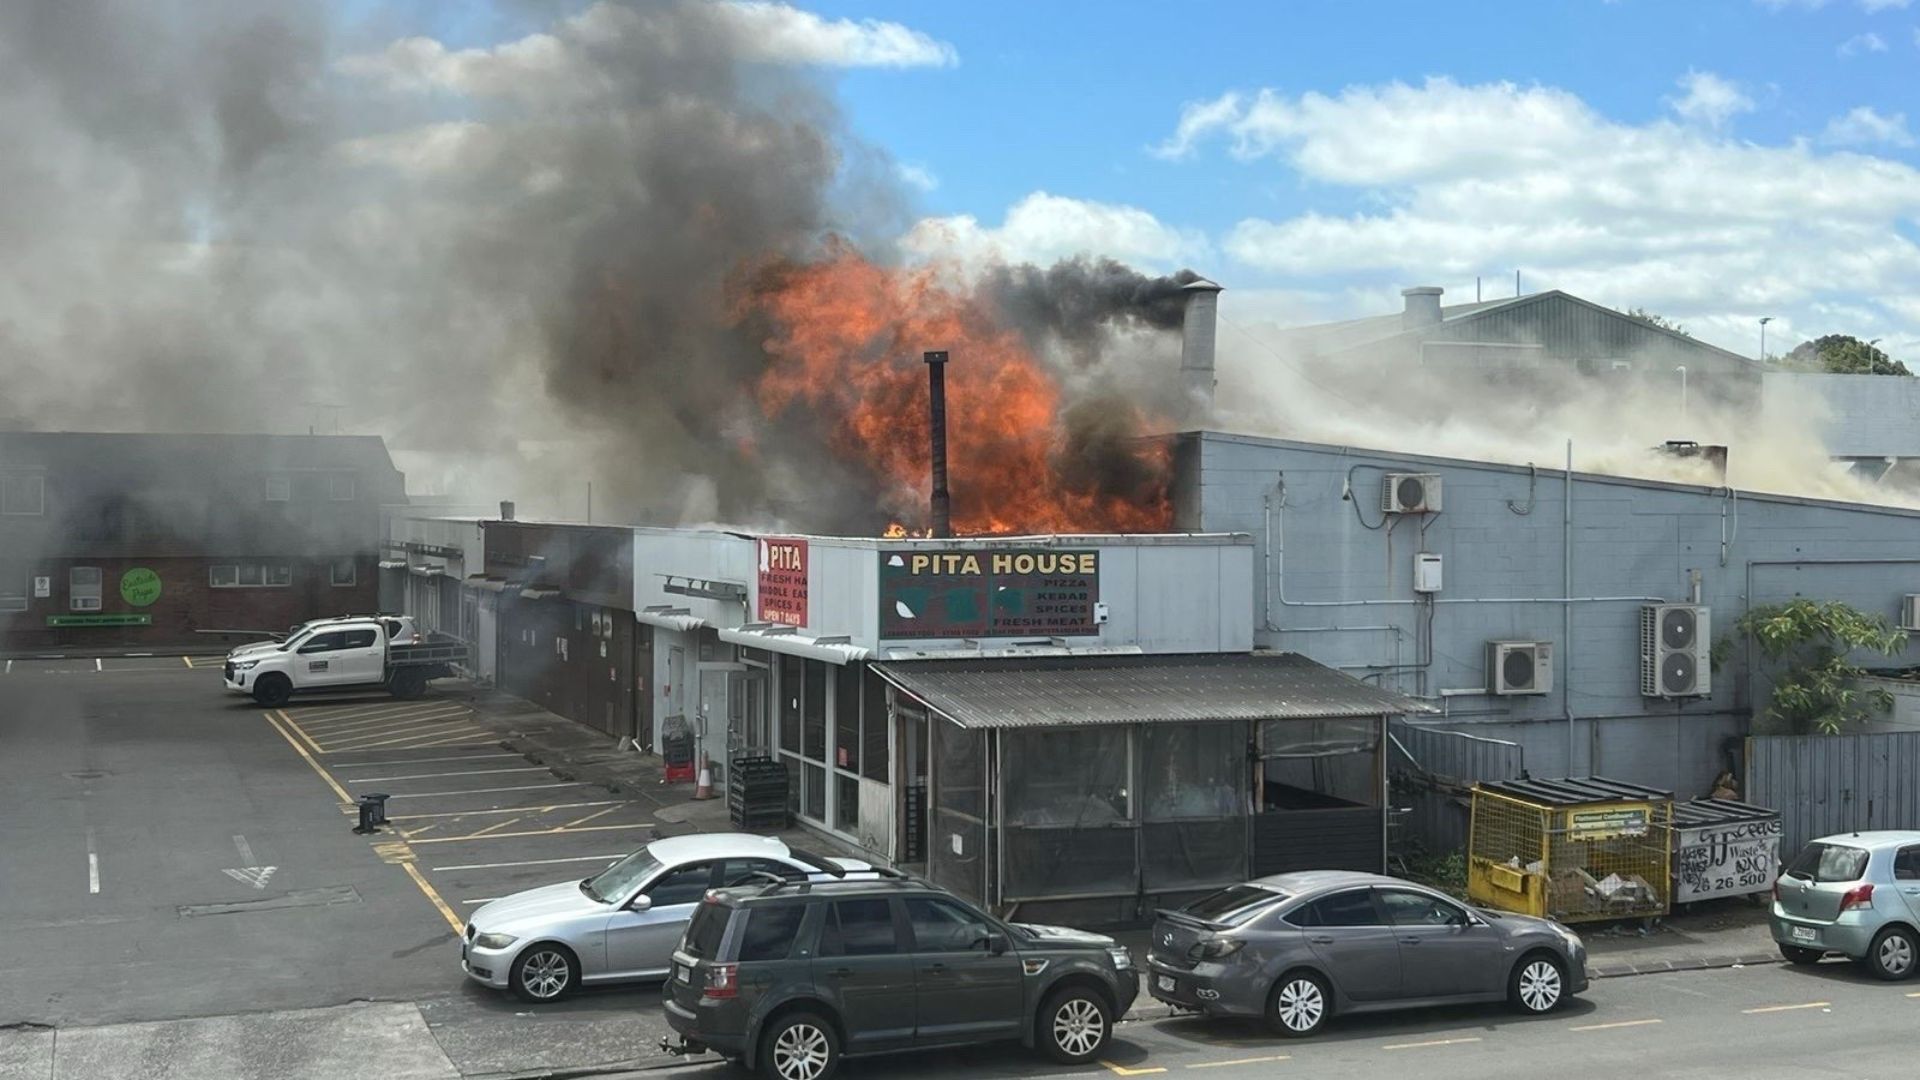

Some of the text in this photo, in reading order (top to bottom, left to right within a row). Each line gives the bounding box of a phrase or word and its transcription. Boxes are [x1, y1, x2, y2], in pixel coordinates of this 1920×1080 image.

[770, 545, 802, 571] PITA
[911, 553, 1096, 576] PITA HOUSE
[761, 573, 791, 585] FRESH
[1043, 579, 1087, 588] PIZZA
[1037, 592, 1088, 601] KEBAB
[764, 598, 792, 610] SPICES
[1036, 605, 1087, 614] SPICES
[993, 617, 1086, 627] FRESH MEAT
[1715, 877, 1734, 890] 26
[1739, 873, 1766, 887] 500
